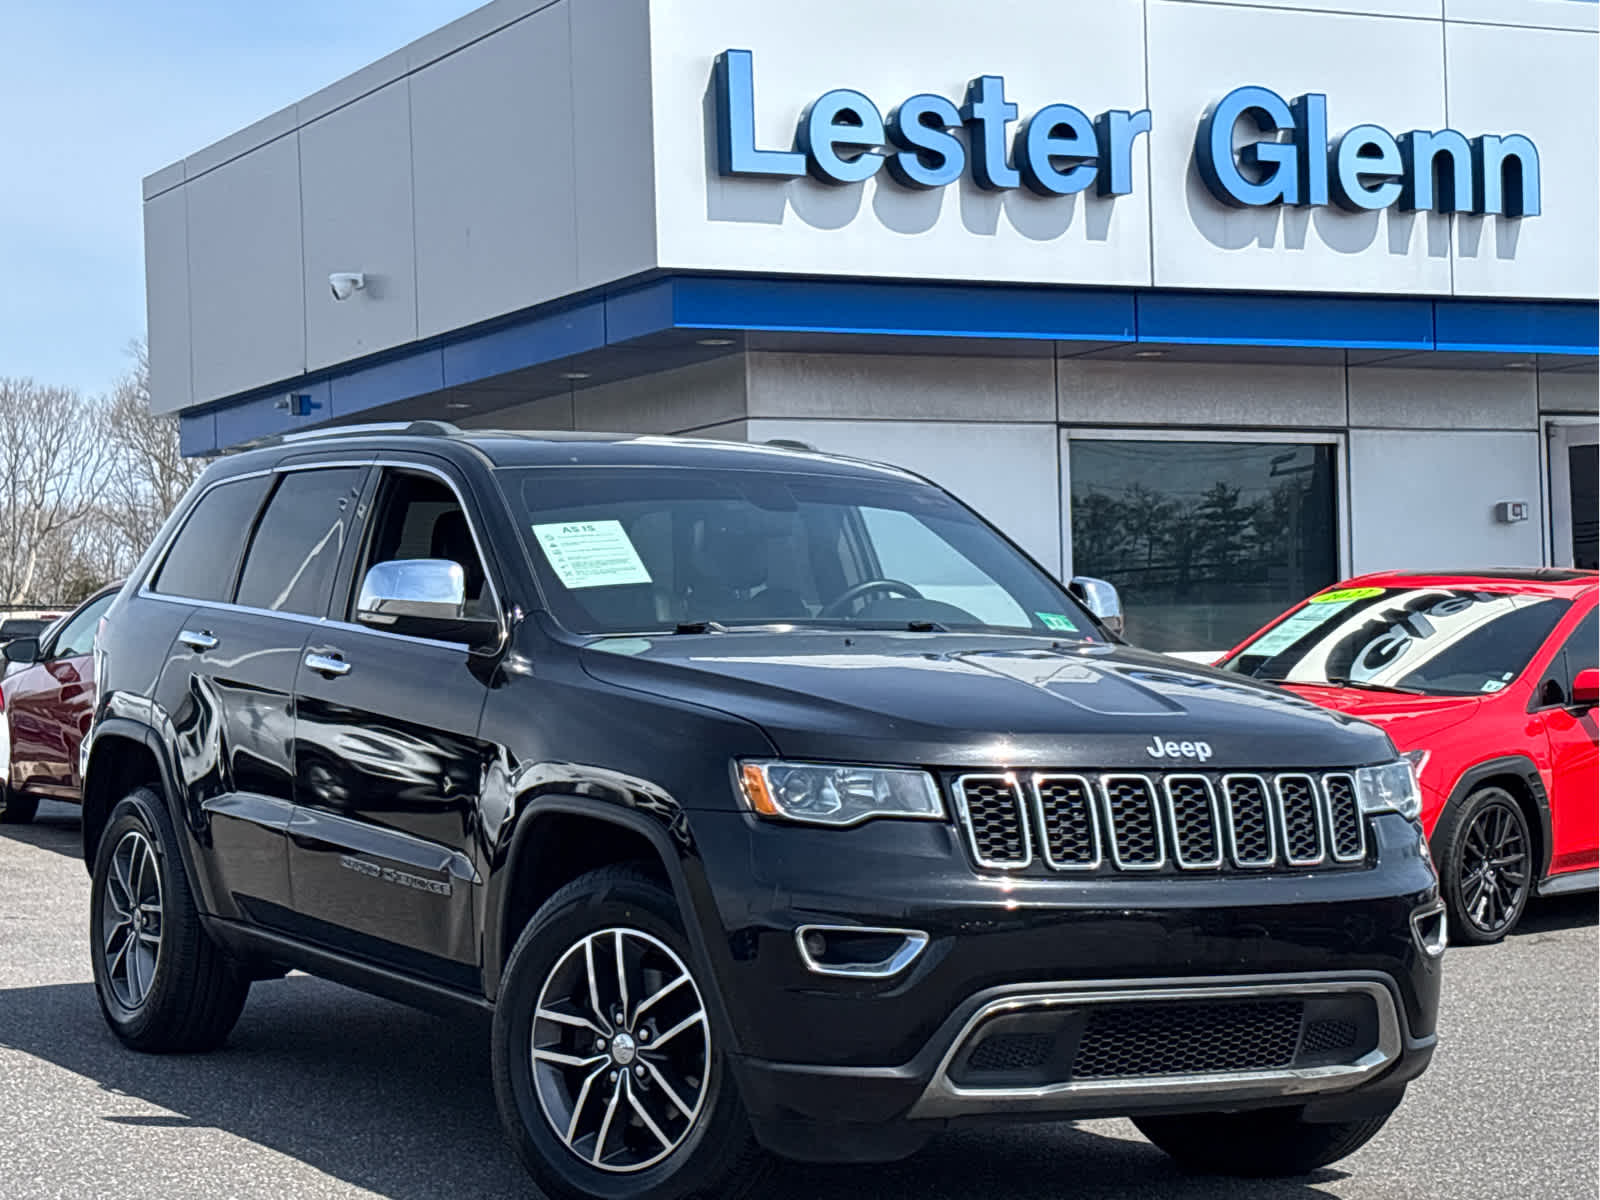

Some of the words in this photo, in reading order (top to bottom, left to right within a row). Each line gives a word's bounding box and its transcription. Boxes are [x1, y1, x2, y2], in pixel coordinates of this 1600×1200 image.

[714, 49, 1151, 195] Lester
[1199, 86, 1541, 217] Glenn
[1146, 735, 1212, 762] Jeep
